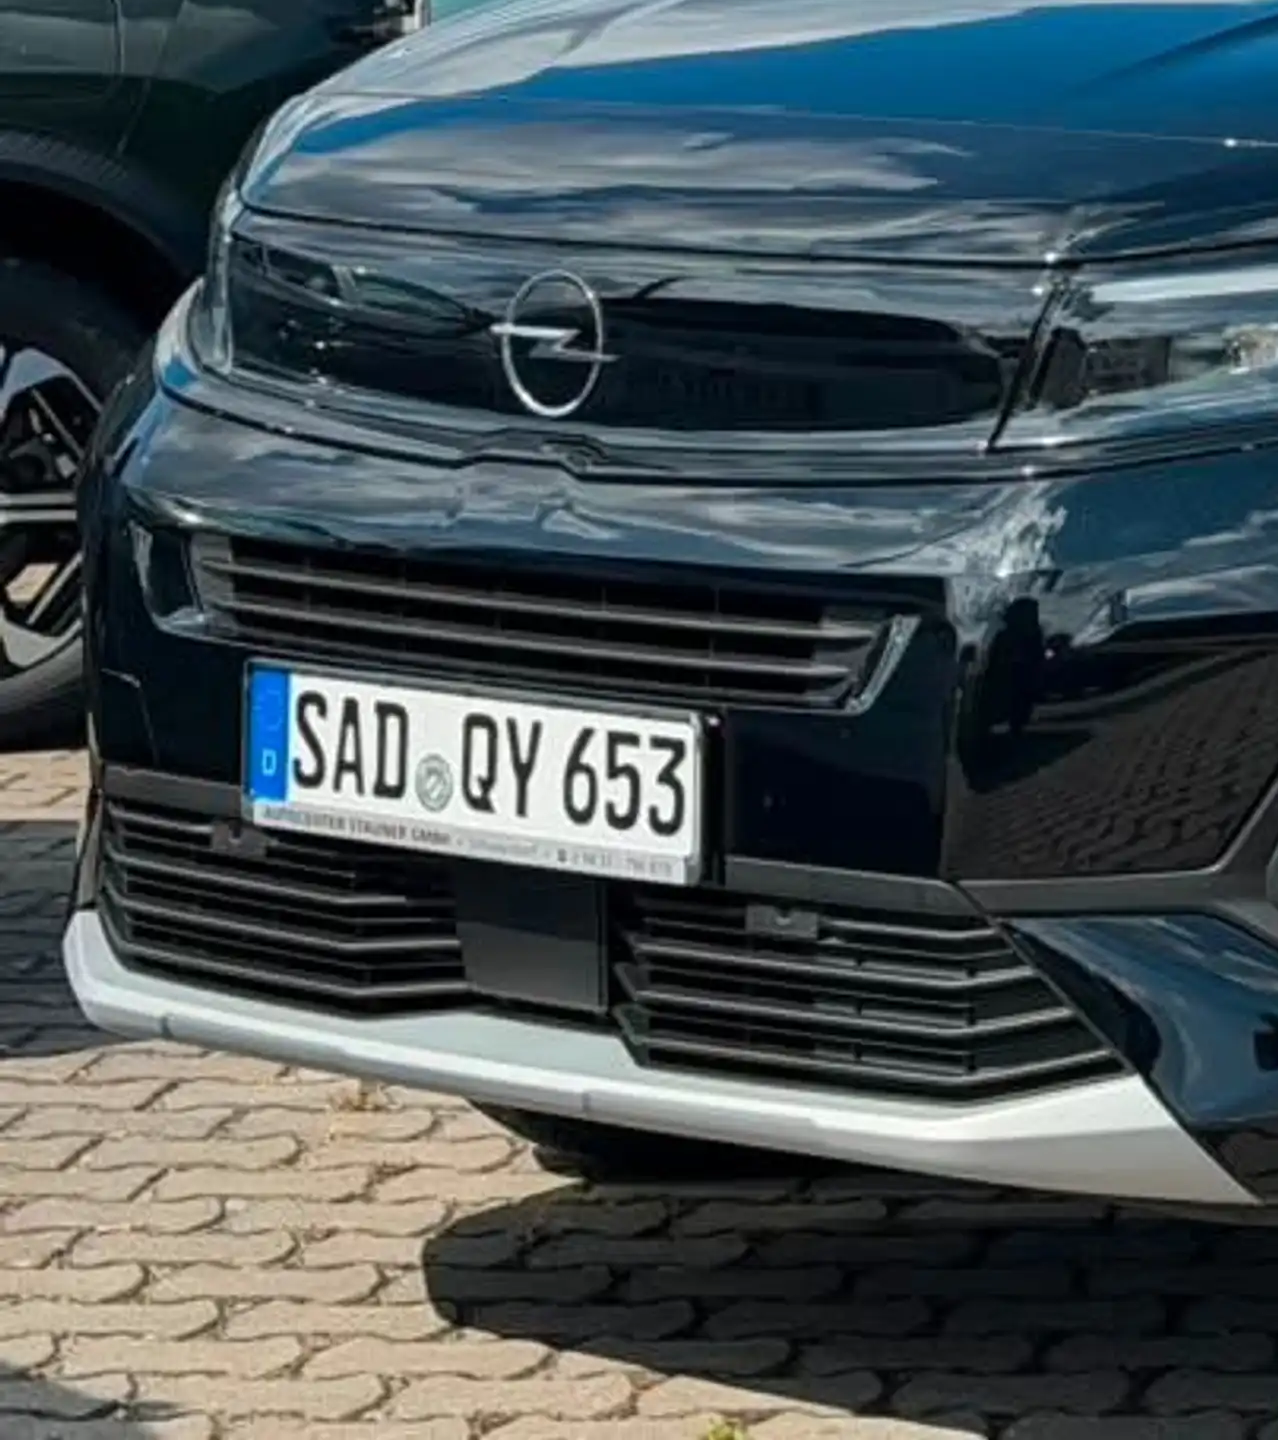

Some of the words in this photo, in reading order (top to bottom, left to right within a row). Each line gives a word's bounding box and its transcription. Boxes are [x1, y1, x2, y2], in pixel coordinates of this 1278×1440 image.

[292, 691, 409, 801] SAD
[461, 713, 543, 818] QY
[563, 726, 686, 837] 653
